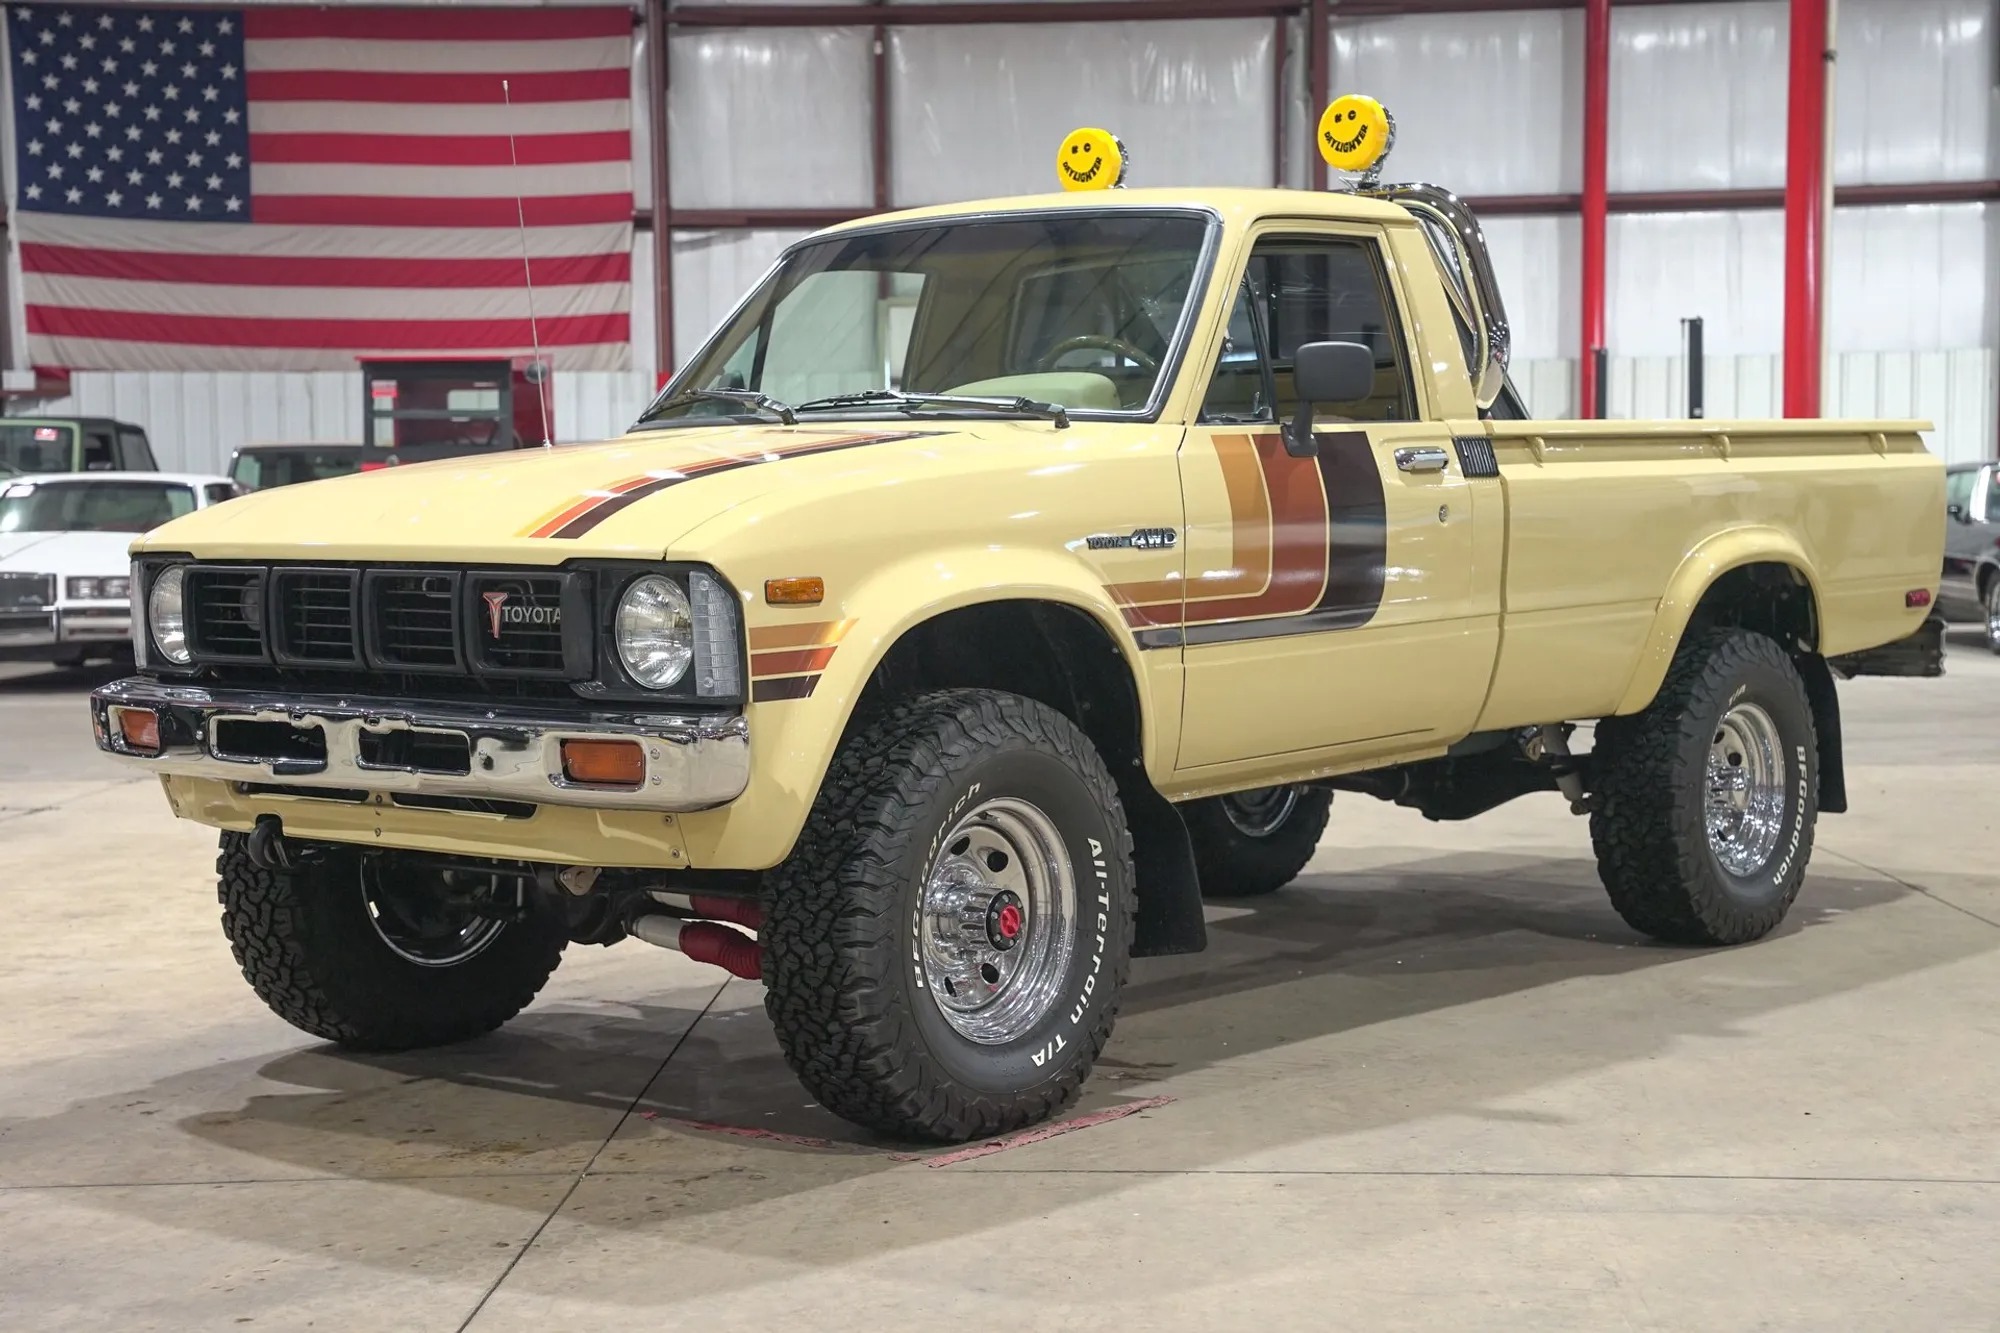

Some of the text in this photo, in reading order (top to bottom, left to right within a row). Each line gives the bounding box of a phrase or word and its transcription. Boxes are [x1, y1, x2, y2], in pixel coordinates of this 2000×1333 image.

[1324, 124, 1368, 153] DAYLIGHTER
[1063, 157, 1102, 183] DAYLIGHTER
[1130, 527, 1177, 549] 4WD
[501, 606, 561, 624] TOYOTA
[1772, 745, 1808, 886] BFGoodrich
[911, 781, 981, 989] BFGoodrich
[1031, 837, 1110, 1067] All-Terrain T/A
